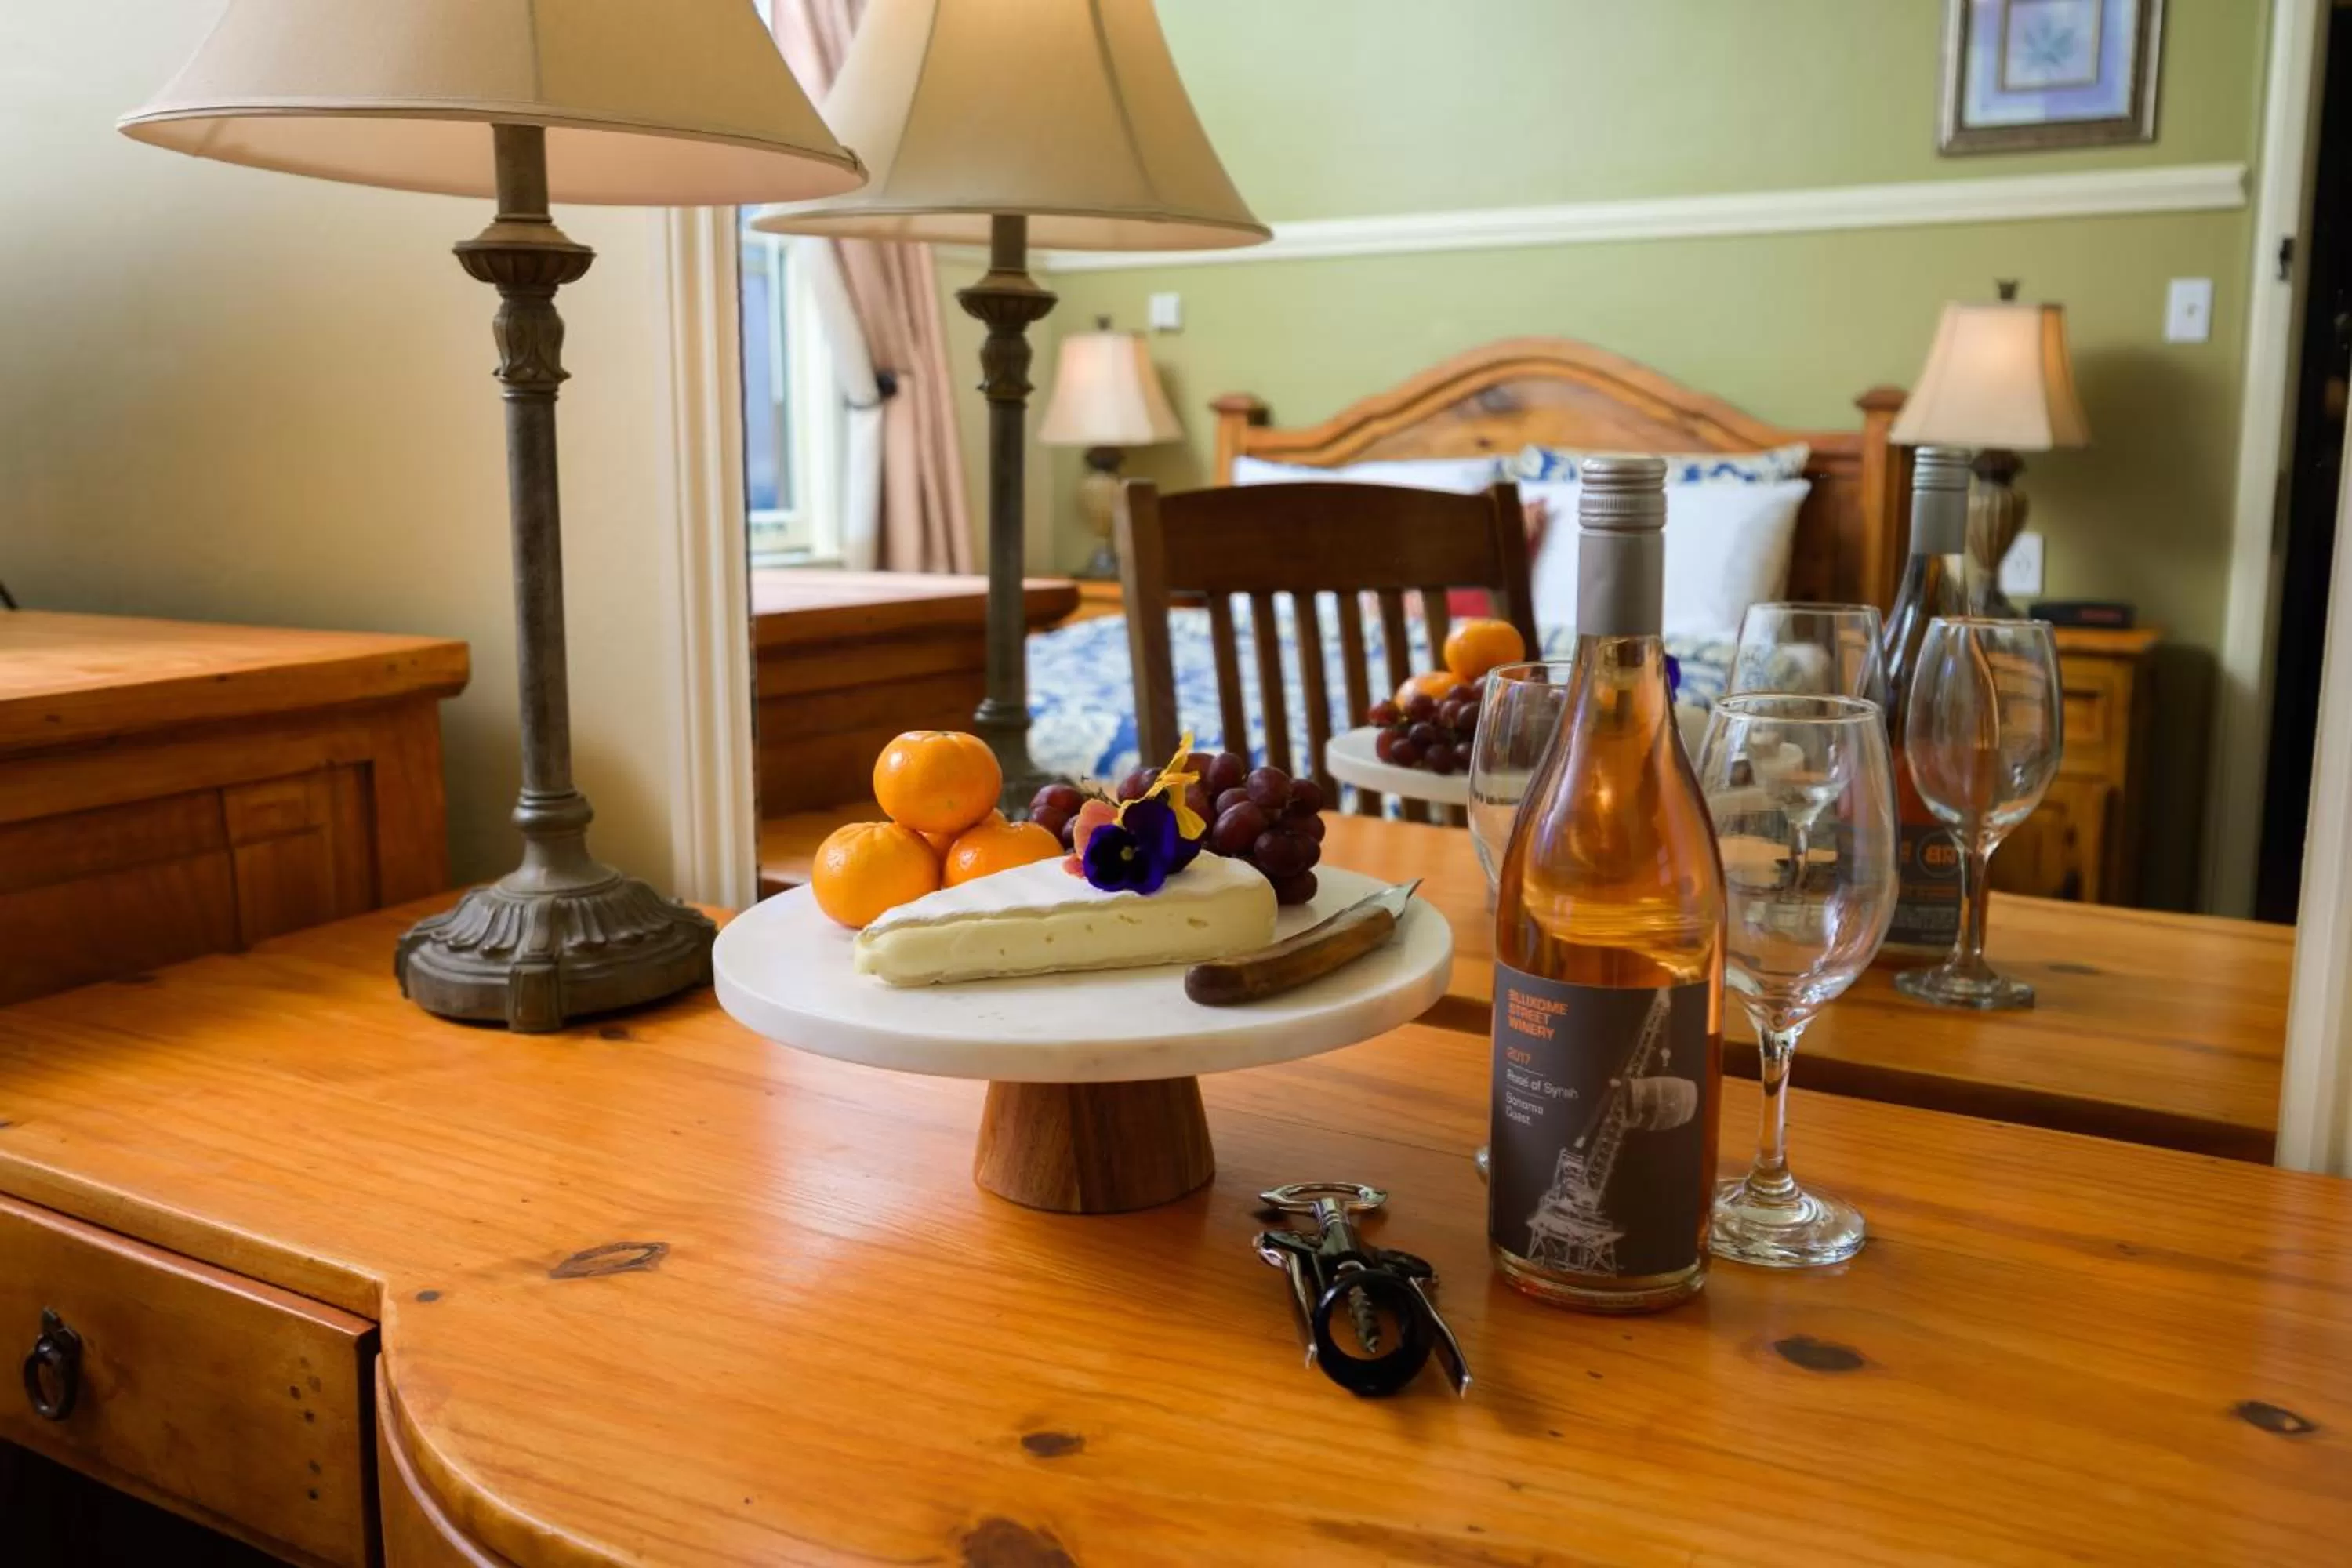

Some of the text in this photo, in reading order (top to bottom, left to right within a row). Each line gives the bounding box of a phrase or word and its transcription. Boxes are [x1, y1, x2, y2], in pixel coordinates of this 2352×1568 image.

[1508, 989, 1569, 1015] BLUXOME
[1508, 1002, 1551, 1025] STREET
[1508, 1016, 1555, 1042] WINERY
[1507, 1047, 1531, 1065] 2017
[1530, 1080, 1541, 1091] of
[1506, 1091, 1544, 1116] Sonoma
[1506, 1105, 1531, 1126] Coast
